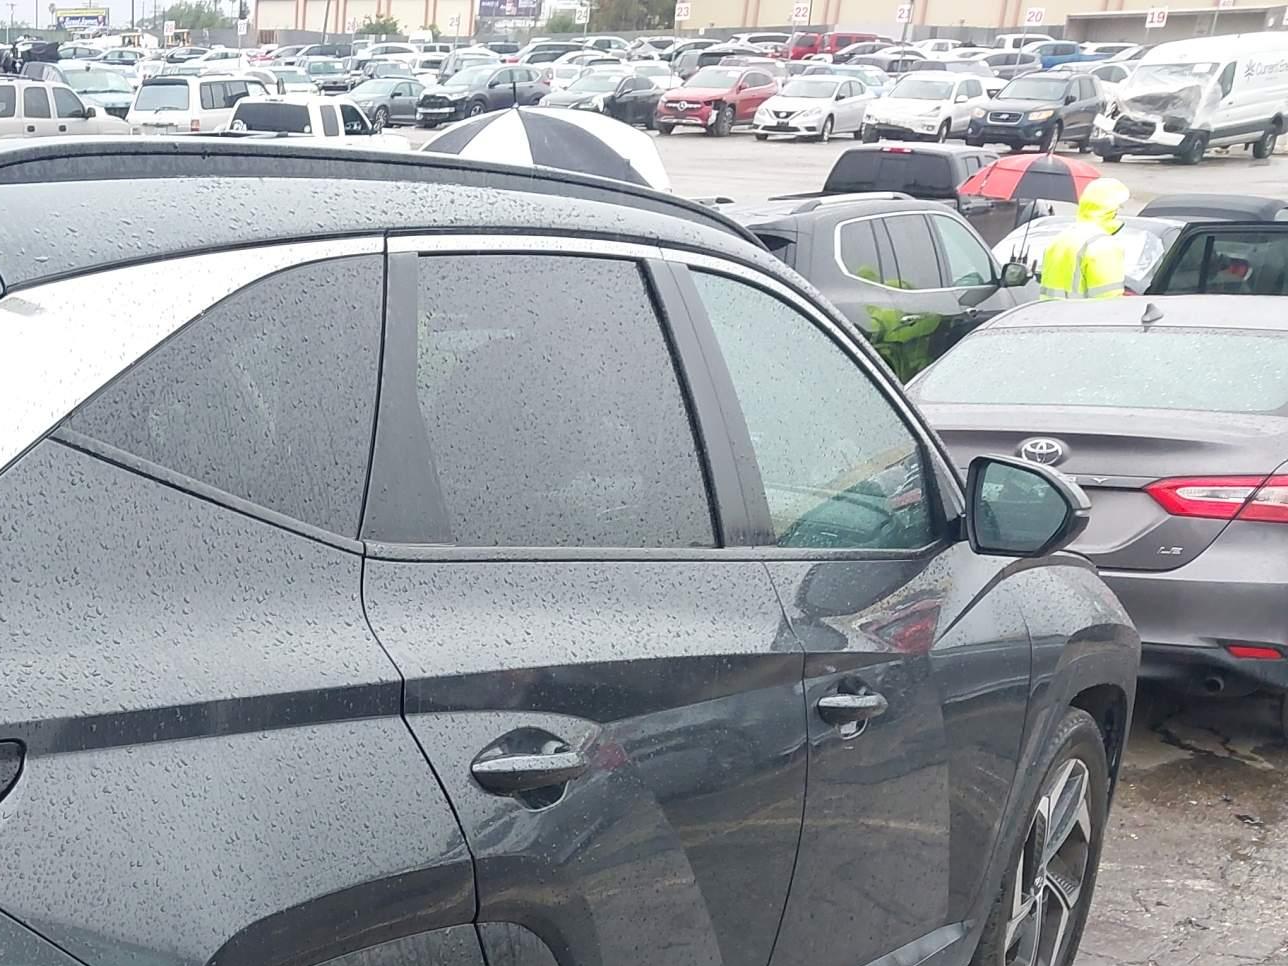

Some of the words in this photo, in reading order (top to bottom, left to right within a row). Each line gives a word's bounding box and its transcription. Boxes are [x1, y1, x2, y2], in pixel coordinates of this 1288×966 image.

[677, 6, 689, 17] 23
[794, 7, 809, 17] 22
[1027, 11, 1043, 22] 20
[1148, 12, 1166, 24] 19
[1157, 546, 1183, 555] LE
